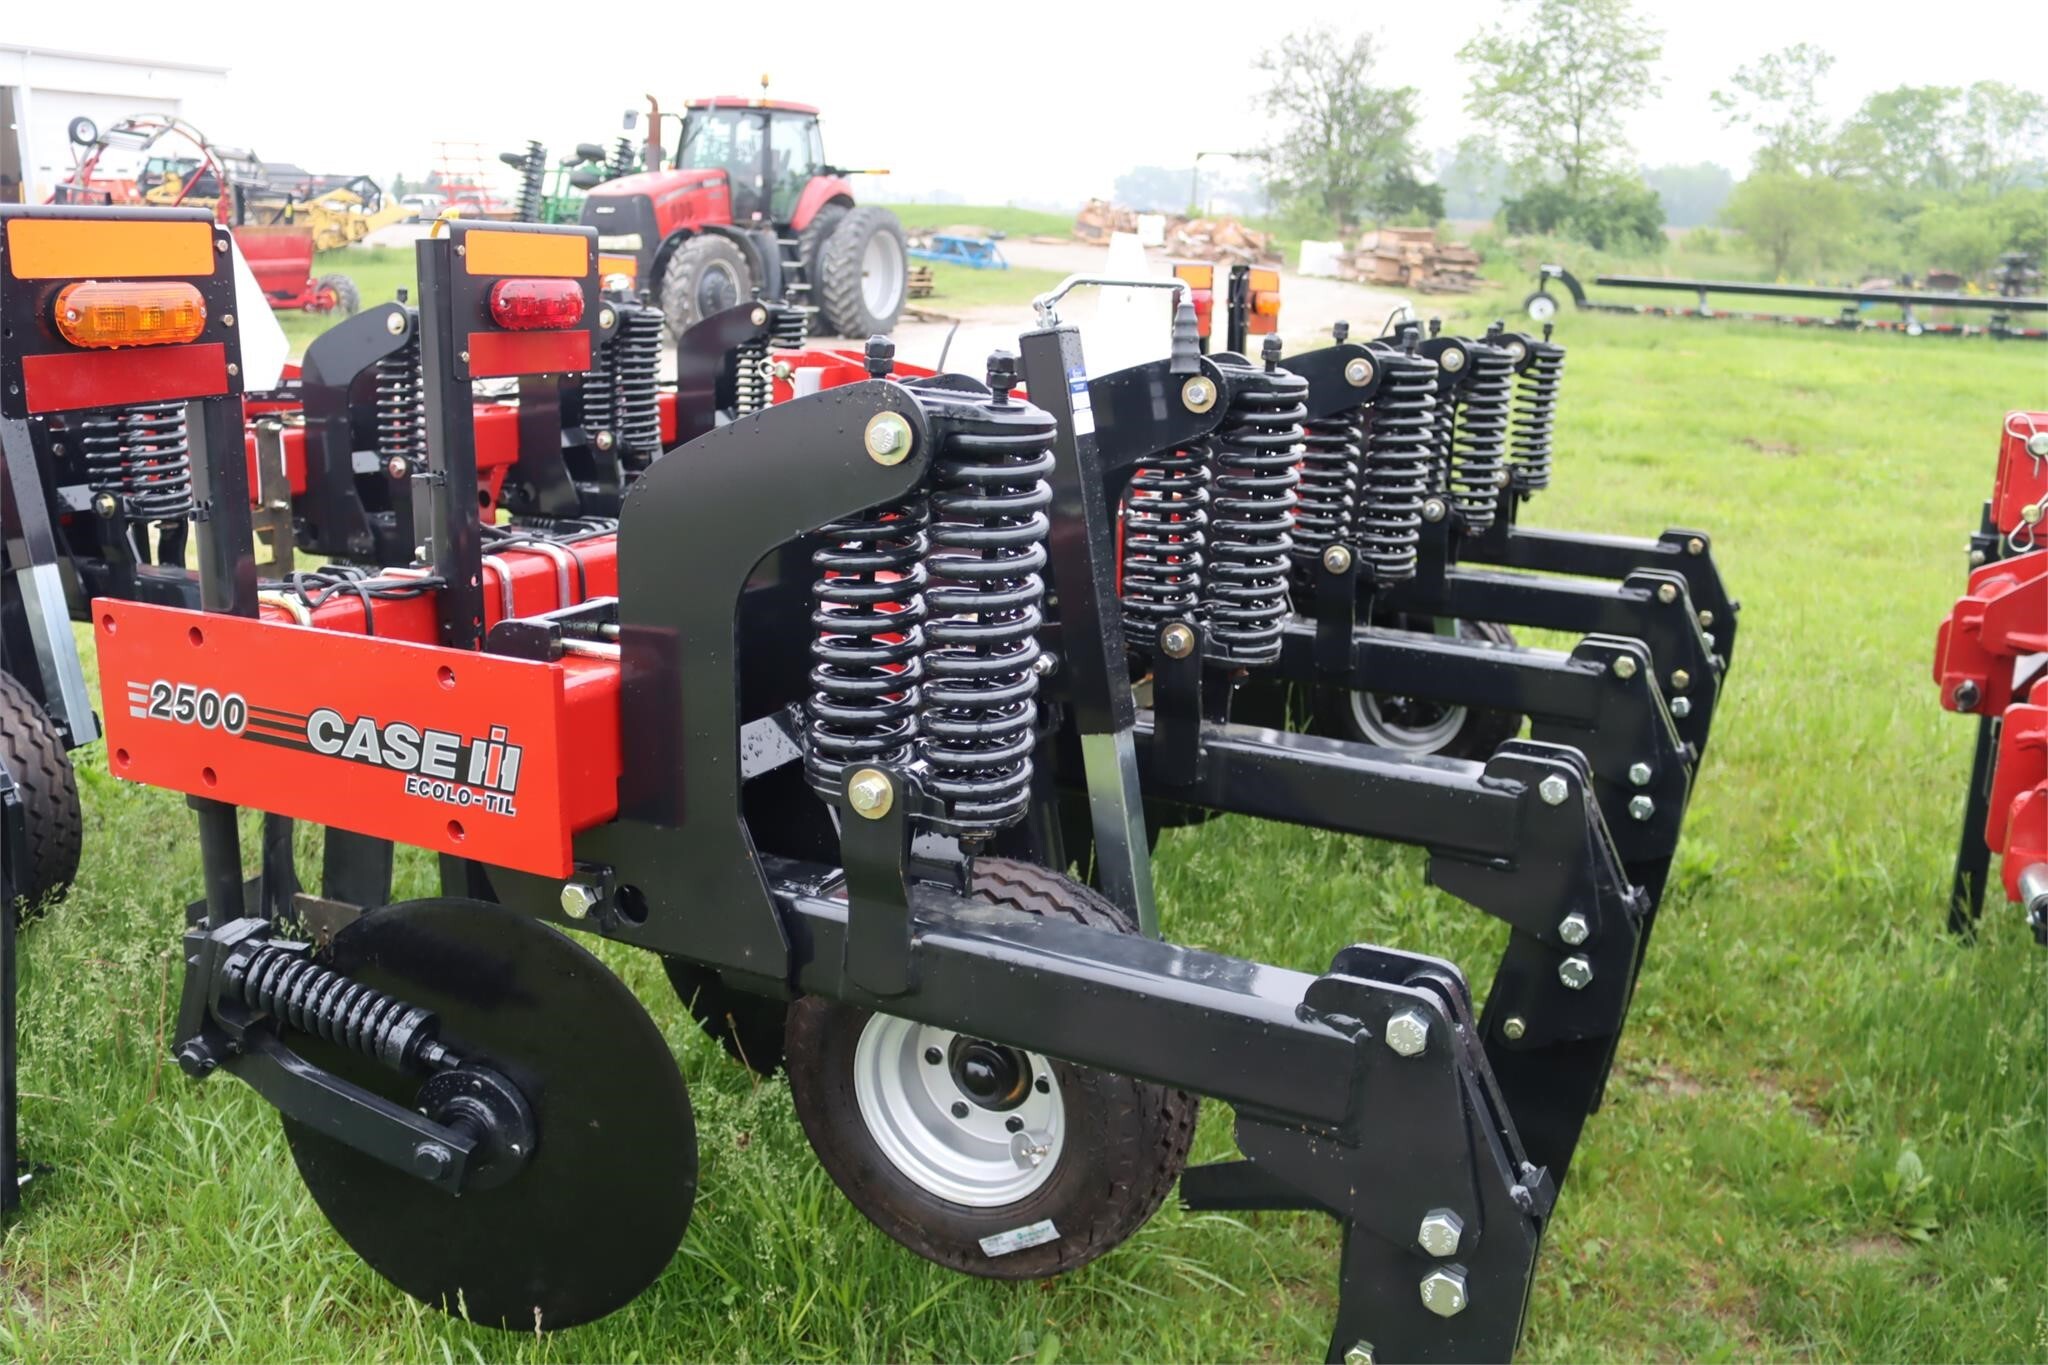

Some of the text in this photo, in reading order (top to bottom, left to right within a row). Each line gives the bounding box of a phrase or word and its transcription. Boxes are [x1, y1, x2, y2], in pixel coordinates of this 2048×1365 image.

[149, 680, 248, 734] 2500
[306, 708, 461, 779] CASE
[405, 774, 517, 816] ECOLO-TIL
